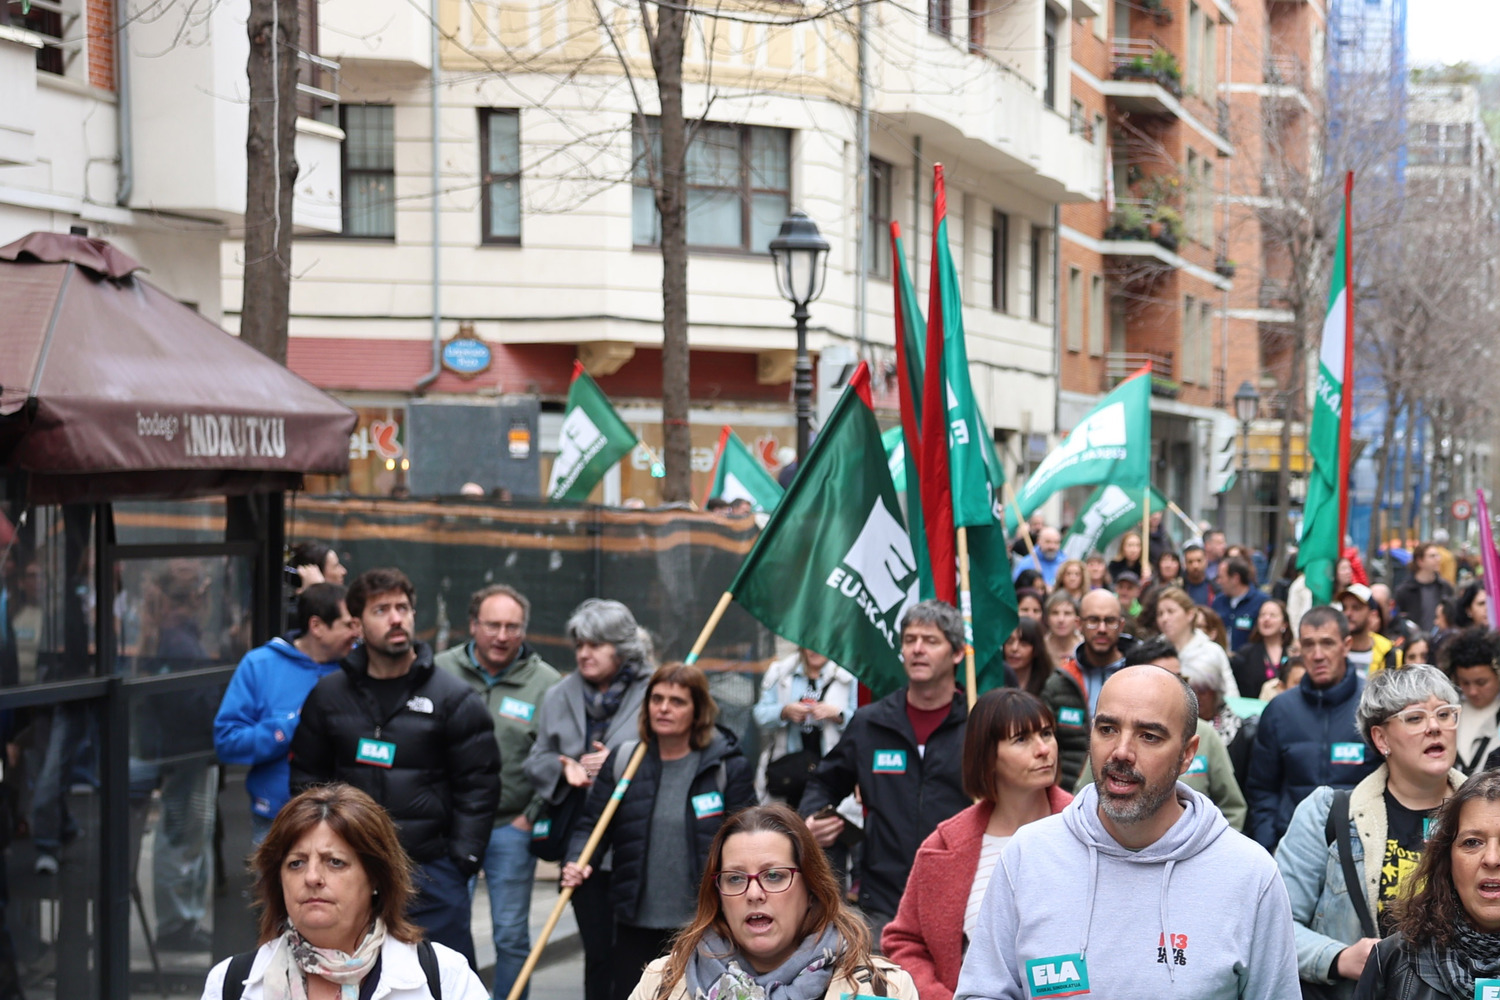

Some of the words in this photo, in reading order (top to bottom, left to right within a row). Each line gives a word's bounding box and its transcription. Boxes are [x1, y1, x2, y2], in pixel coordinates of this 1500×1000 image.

[361, 742, 390, 760] ELA
[877, 753, 904, 767] ELA
[1032, 960, 1081, 987] ELA
